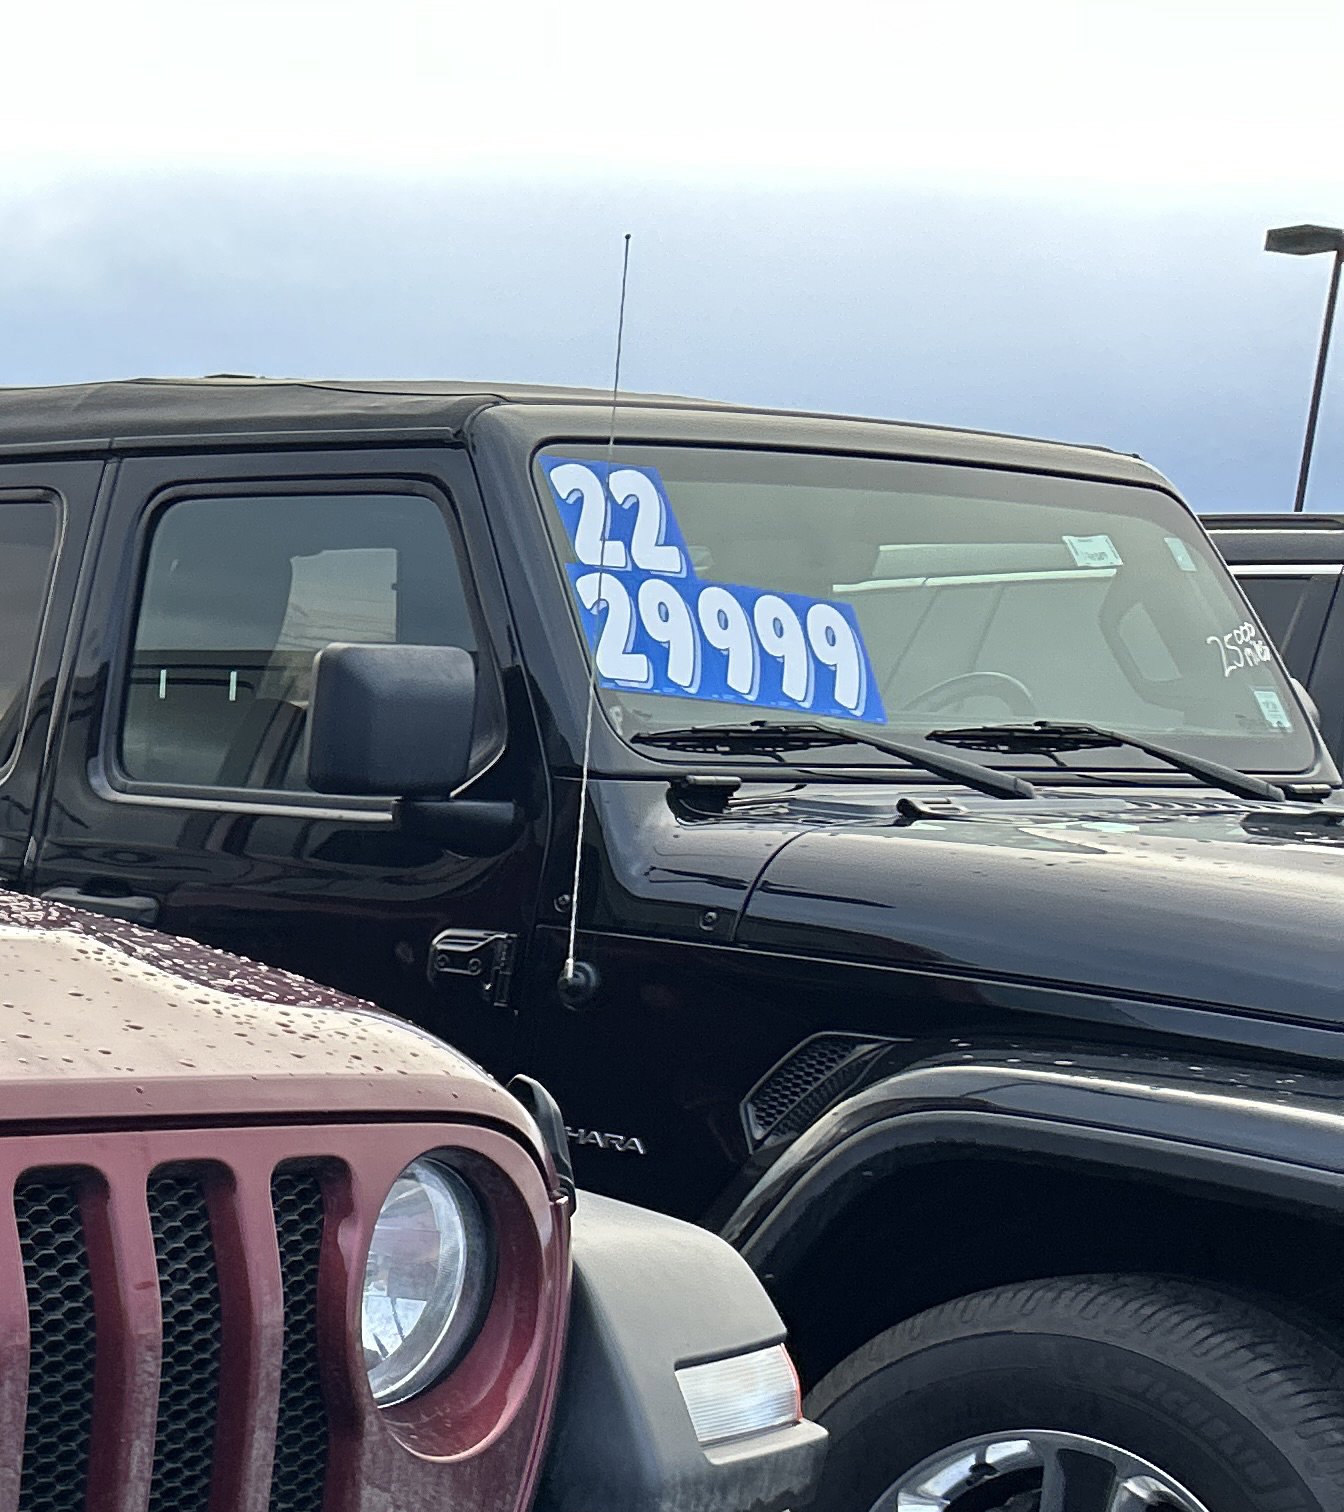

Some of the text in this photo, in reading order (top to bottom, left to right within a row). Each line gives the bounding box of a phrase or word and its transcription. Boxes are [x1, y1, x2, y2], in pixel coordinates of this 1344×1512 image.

[550, 463, 687, 578] 22
[575, 572, 866, 718] 29999
[565, 1126, 646, 1155] HARA
